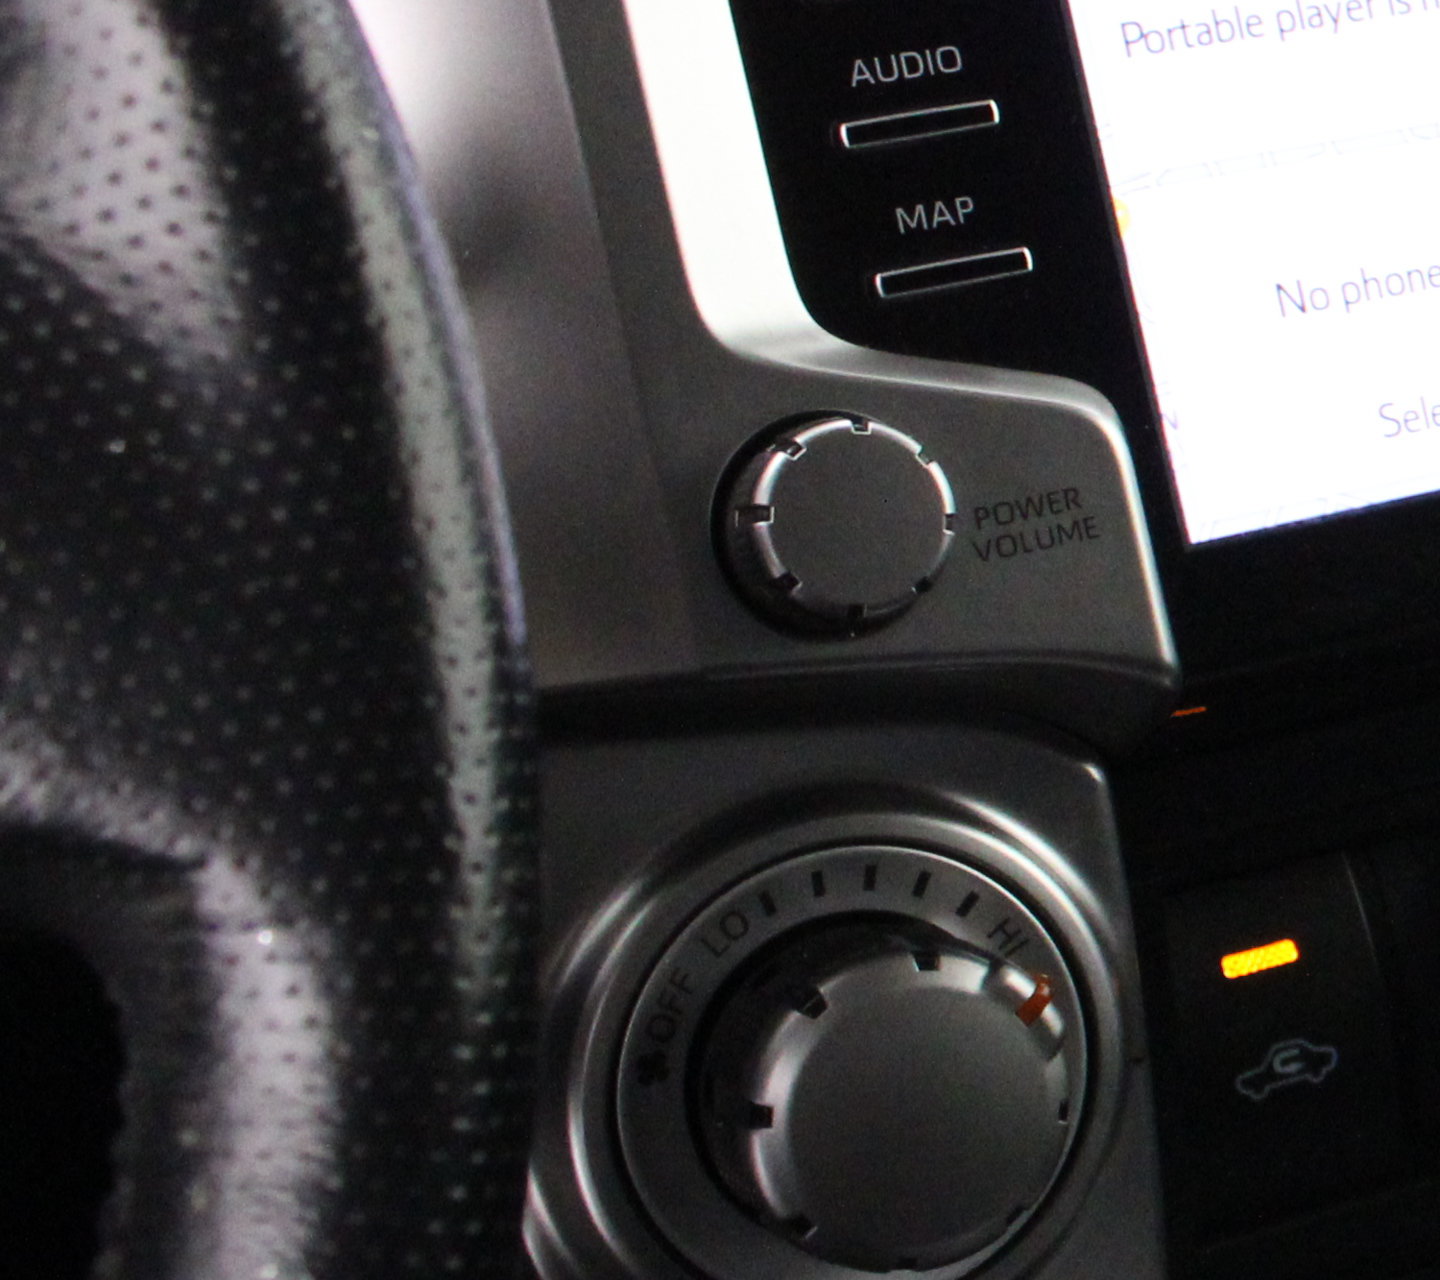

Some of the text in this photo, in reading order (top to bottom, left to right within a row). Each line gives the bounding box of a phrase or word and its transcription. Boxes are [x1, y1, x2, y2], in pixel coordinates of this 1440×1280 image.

[1120, 5, 1265, 58] Portable
[850, 44, 963, 87] AUDIO
[895, 196, 976, 235] MAP
[1275, 281, 1331, 318] No
[973, 487, 1083, 530] POWER
[971, 516, 1100, 563] VOLUME
[700, 911, 750, 958] LO
[986, 917, 1030, 959] HI
[645, 967, 694, 1043] OFF
